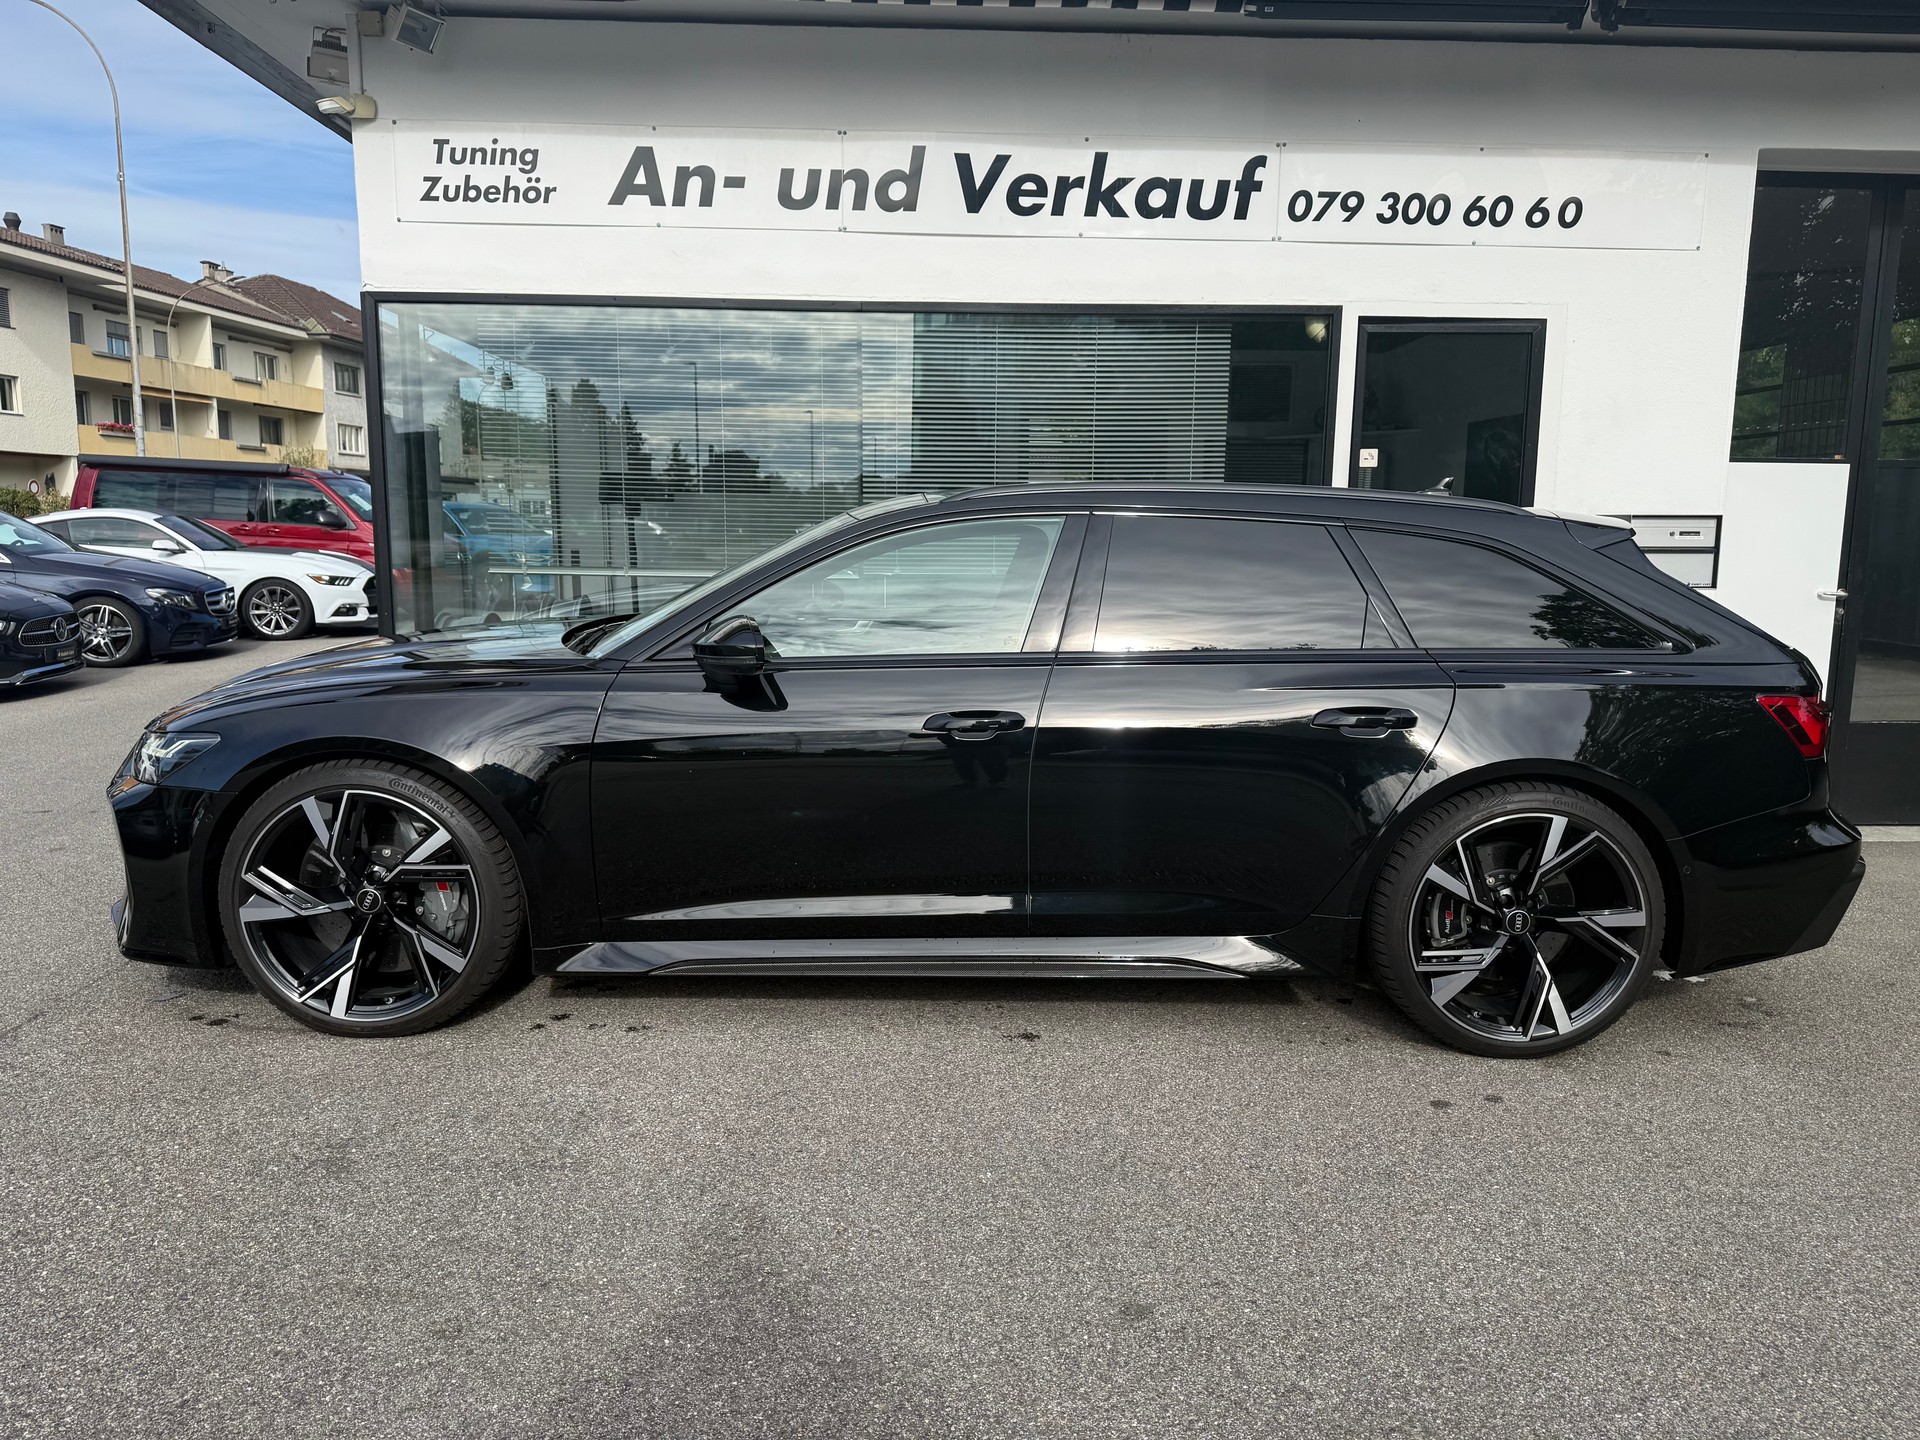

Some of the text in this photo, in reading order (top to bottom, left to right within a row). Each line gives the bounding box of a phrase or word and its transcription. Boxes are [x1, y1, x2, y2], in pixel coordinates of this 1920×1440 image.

[432, 138, 539, 174] Tuning
[419, 174, 558, 204] Zubehör
[607, 145, 1268, 221] An- und Verkauf
[1287, 189, 1365, 223] 079
[1375, 190, 1452, 226] 300
[1462, 195, 1514, 228] 60
[388, 777, 449, 814] Continental
